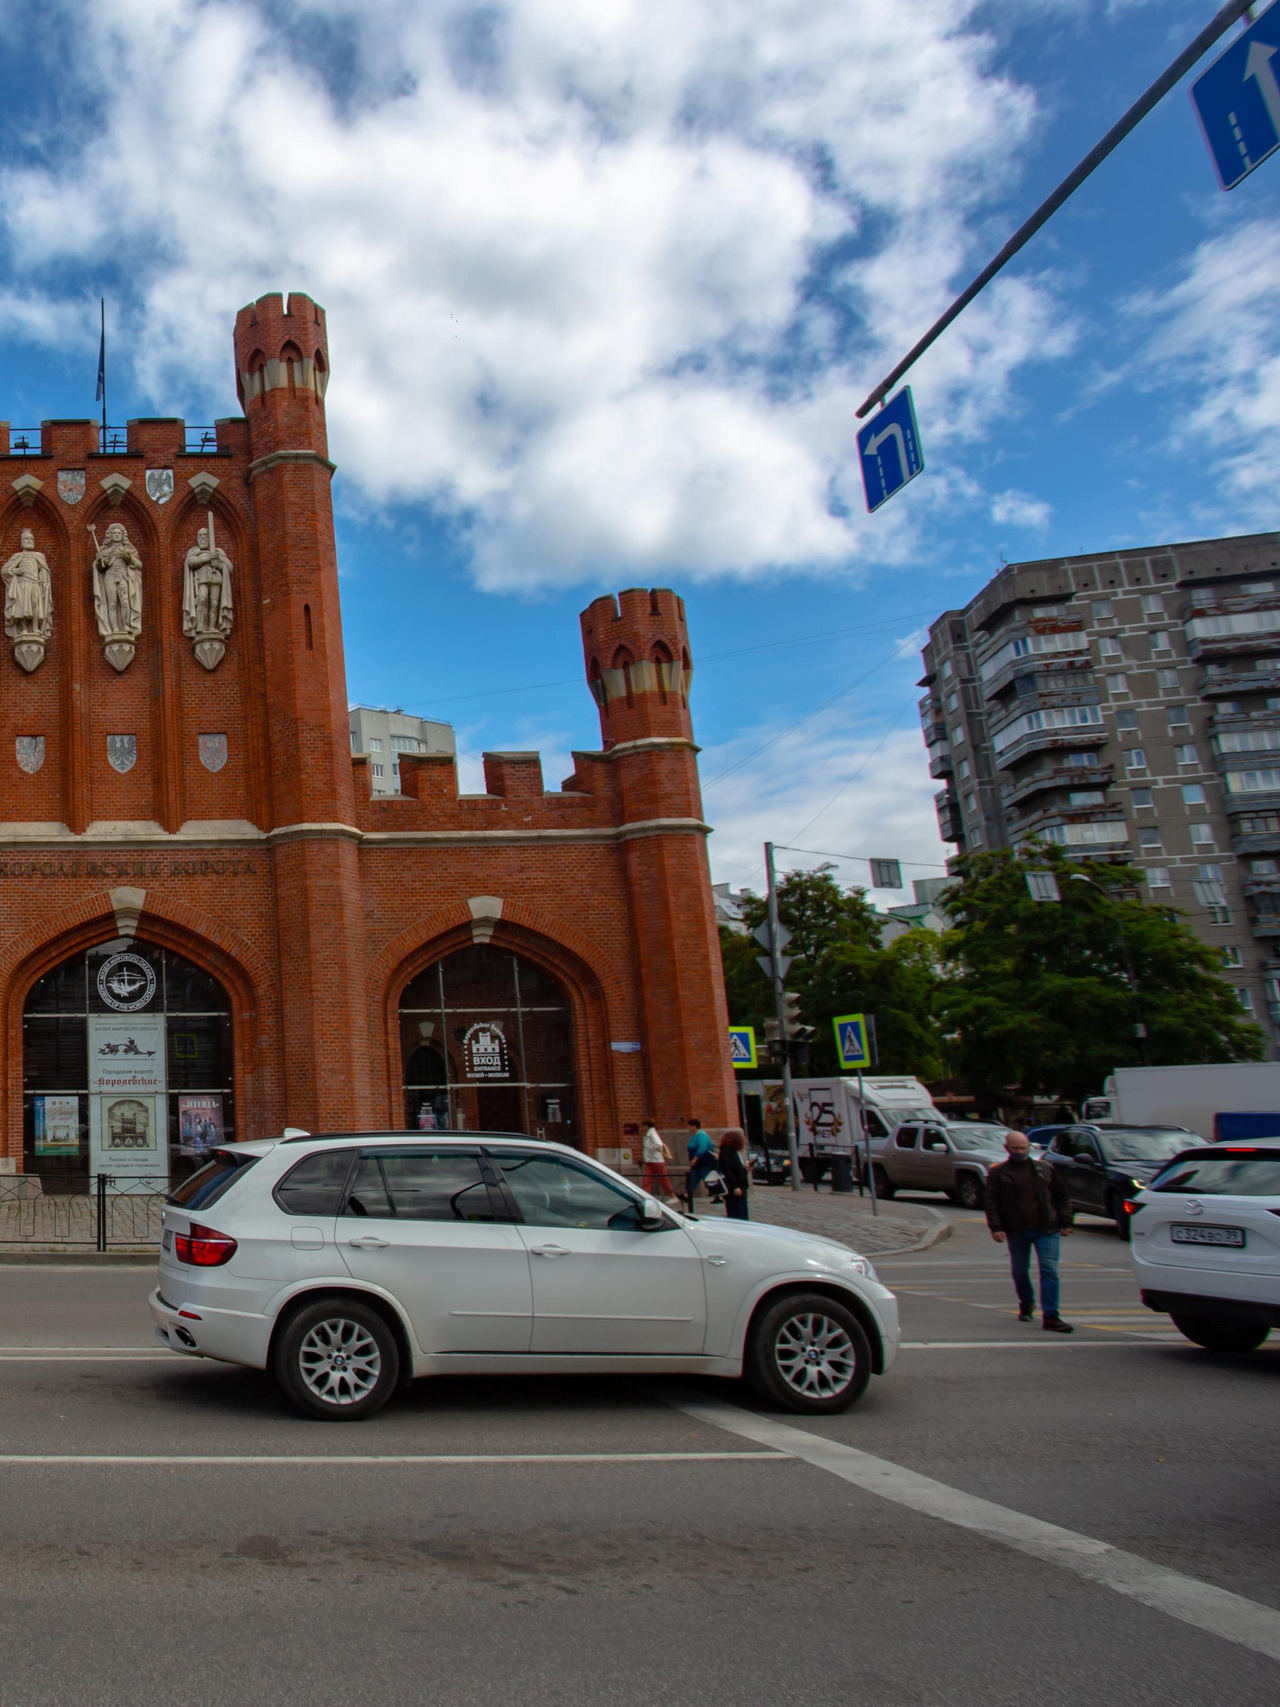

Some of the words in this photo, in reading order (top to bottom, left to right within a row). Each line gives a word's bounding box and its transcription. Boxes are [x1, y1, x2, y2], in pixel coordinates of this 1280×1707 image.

[169, 860, 258, 877] ВОРОТА
[473, 1056, 501, 1065] ВХОД
[810, 1102, 836, 1127] 25
